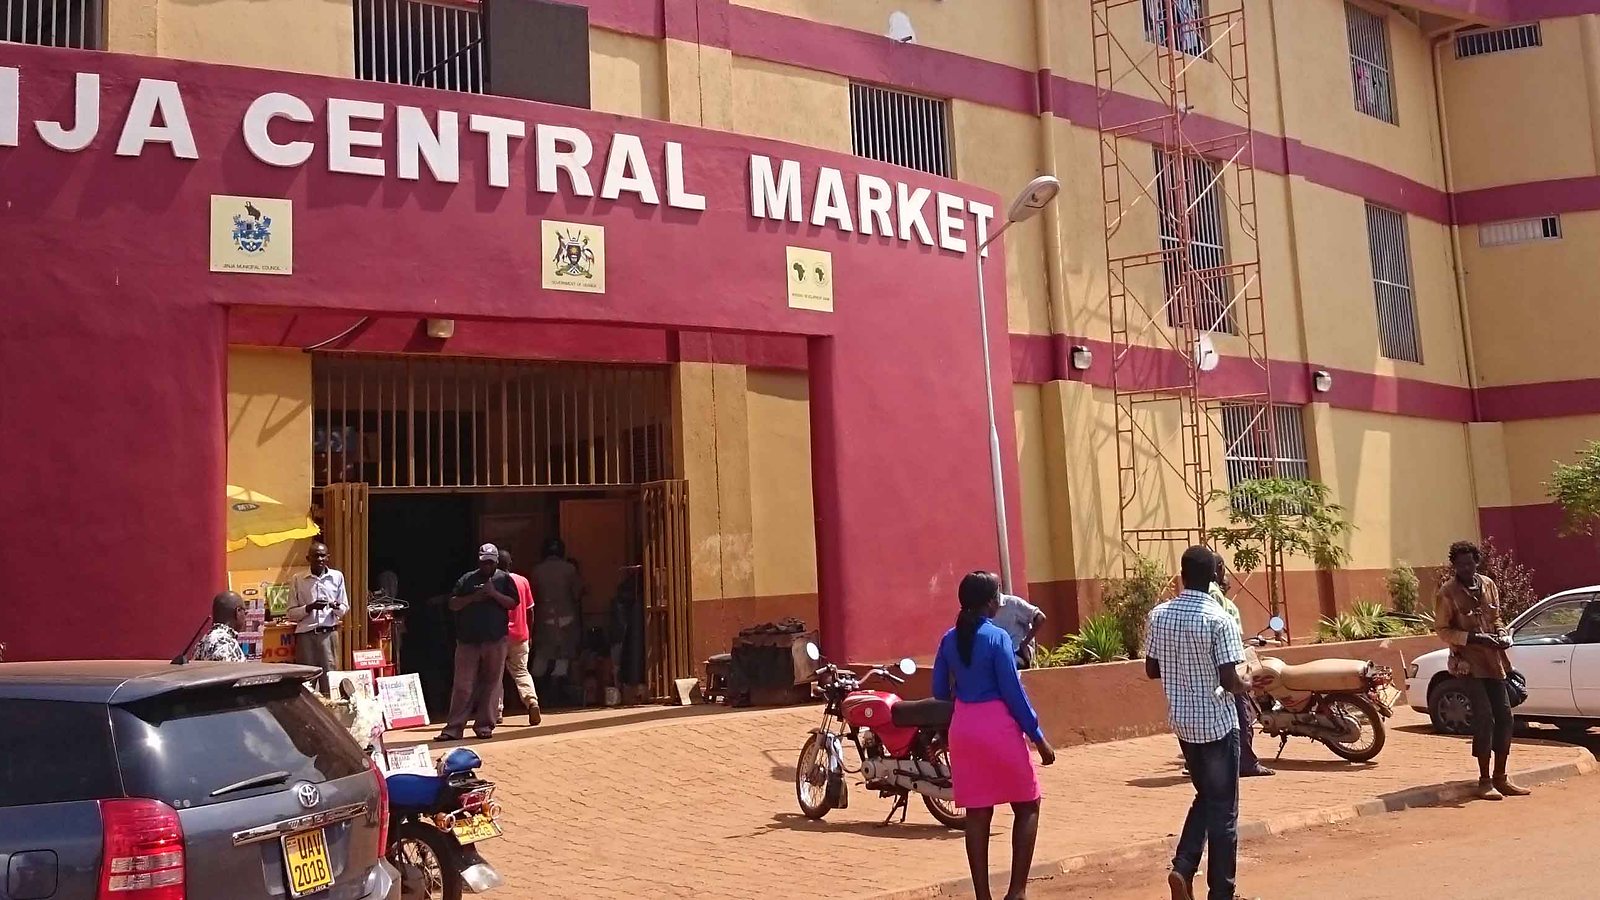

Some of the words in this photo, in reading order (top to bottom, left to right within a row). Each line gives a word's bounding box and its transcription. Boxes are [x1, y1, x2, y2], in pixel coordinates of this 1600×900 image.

[242, 92, 706, 211] CENTRAL
[750, 154, 994, 256] MARKET
[297, 832, 321, 860] UAV
[294, 858, 326, 888] 201B
